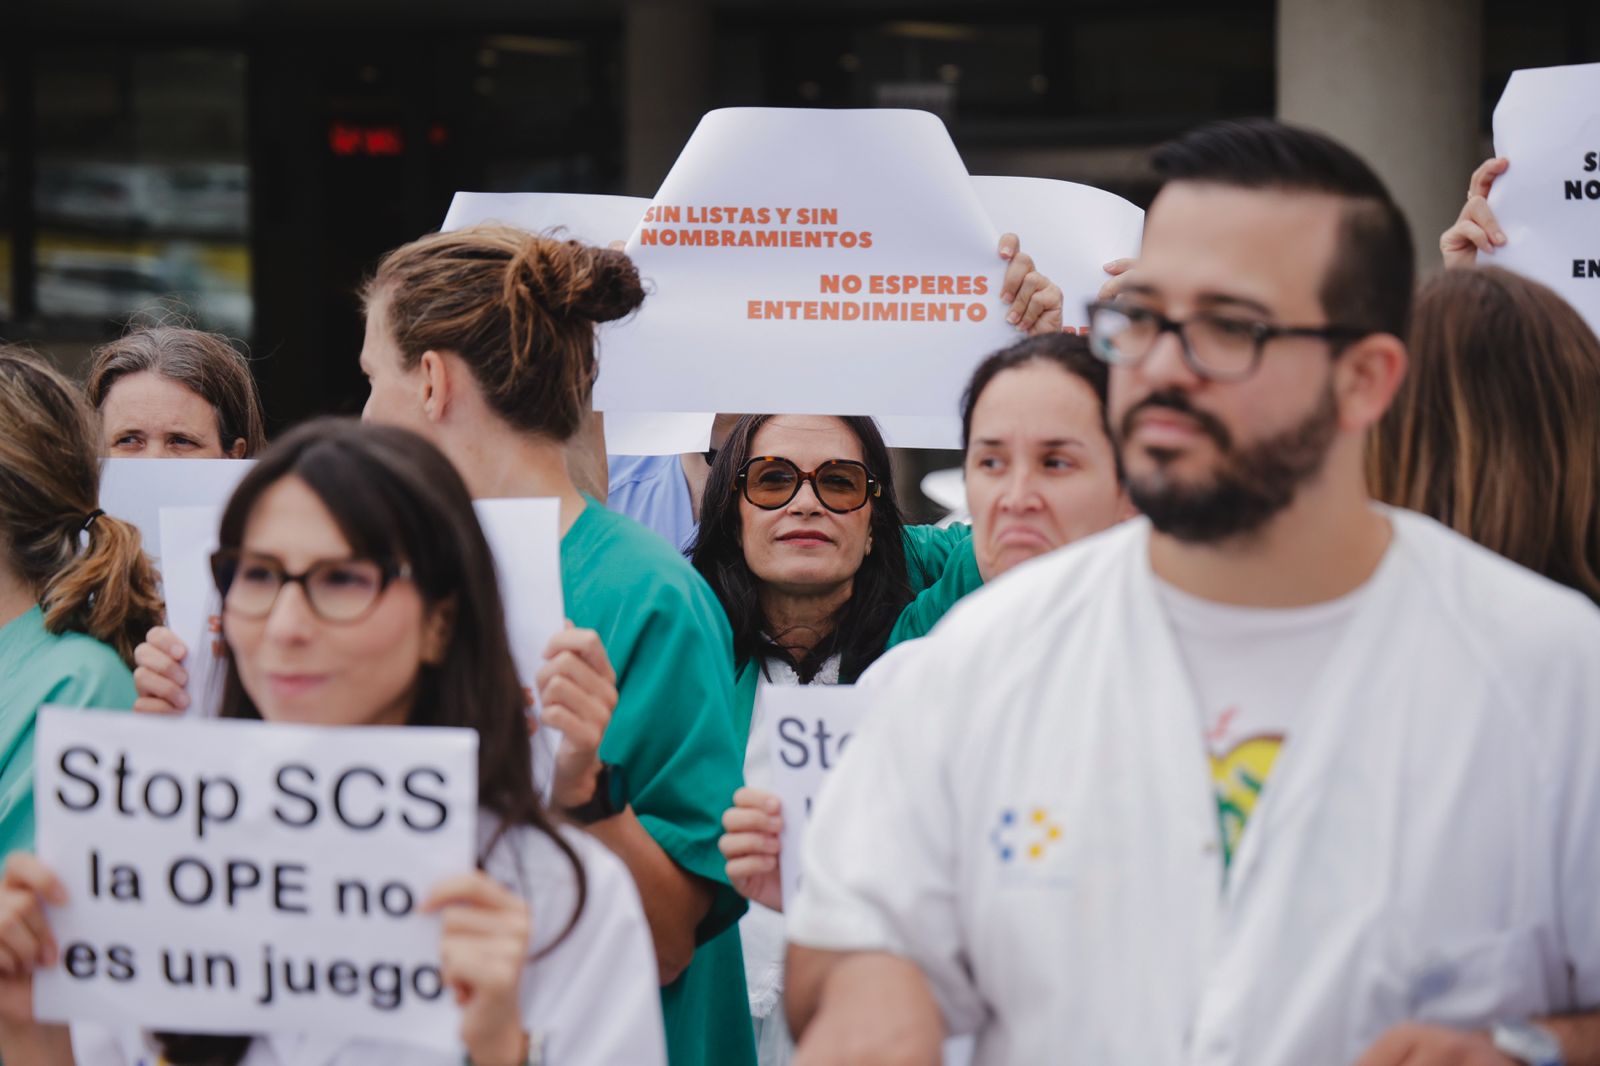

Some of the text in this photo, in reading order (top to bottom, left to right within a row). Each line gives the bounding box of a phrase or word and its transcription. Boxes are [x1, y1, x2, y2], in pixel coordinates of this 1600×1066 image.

[1583, 151, 1600, 172] S
[1564, 179, 1600, 200] NO
[643, 206, 838, 225] SIN LISTAS Y SIN
[640, 228, 873, 249] NOMBRAMIENTOS
[1572, 259, 1600, 278] EN
[819, 274, 989, 296] NO ESPERES
[747, 300, 988, 323] ENTENDIMIENTO
[56, 746, 449, 838] Stop SCS
[90, 850, 415, 917] la OPE no
[63, 942, 444, 1010] es un juego
